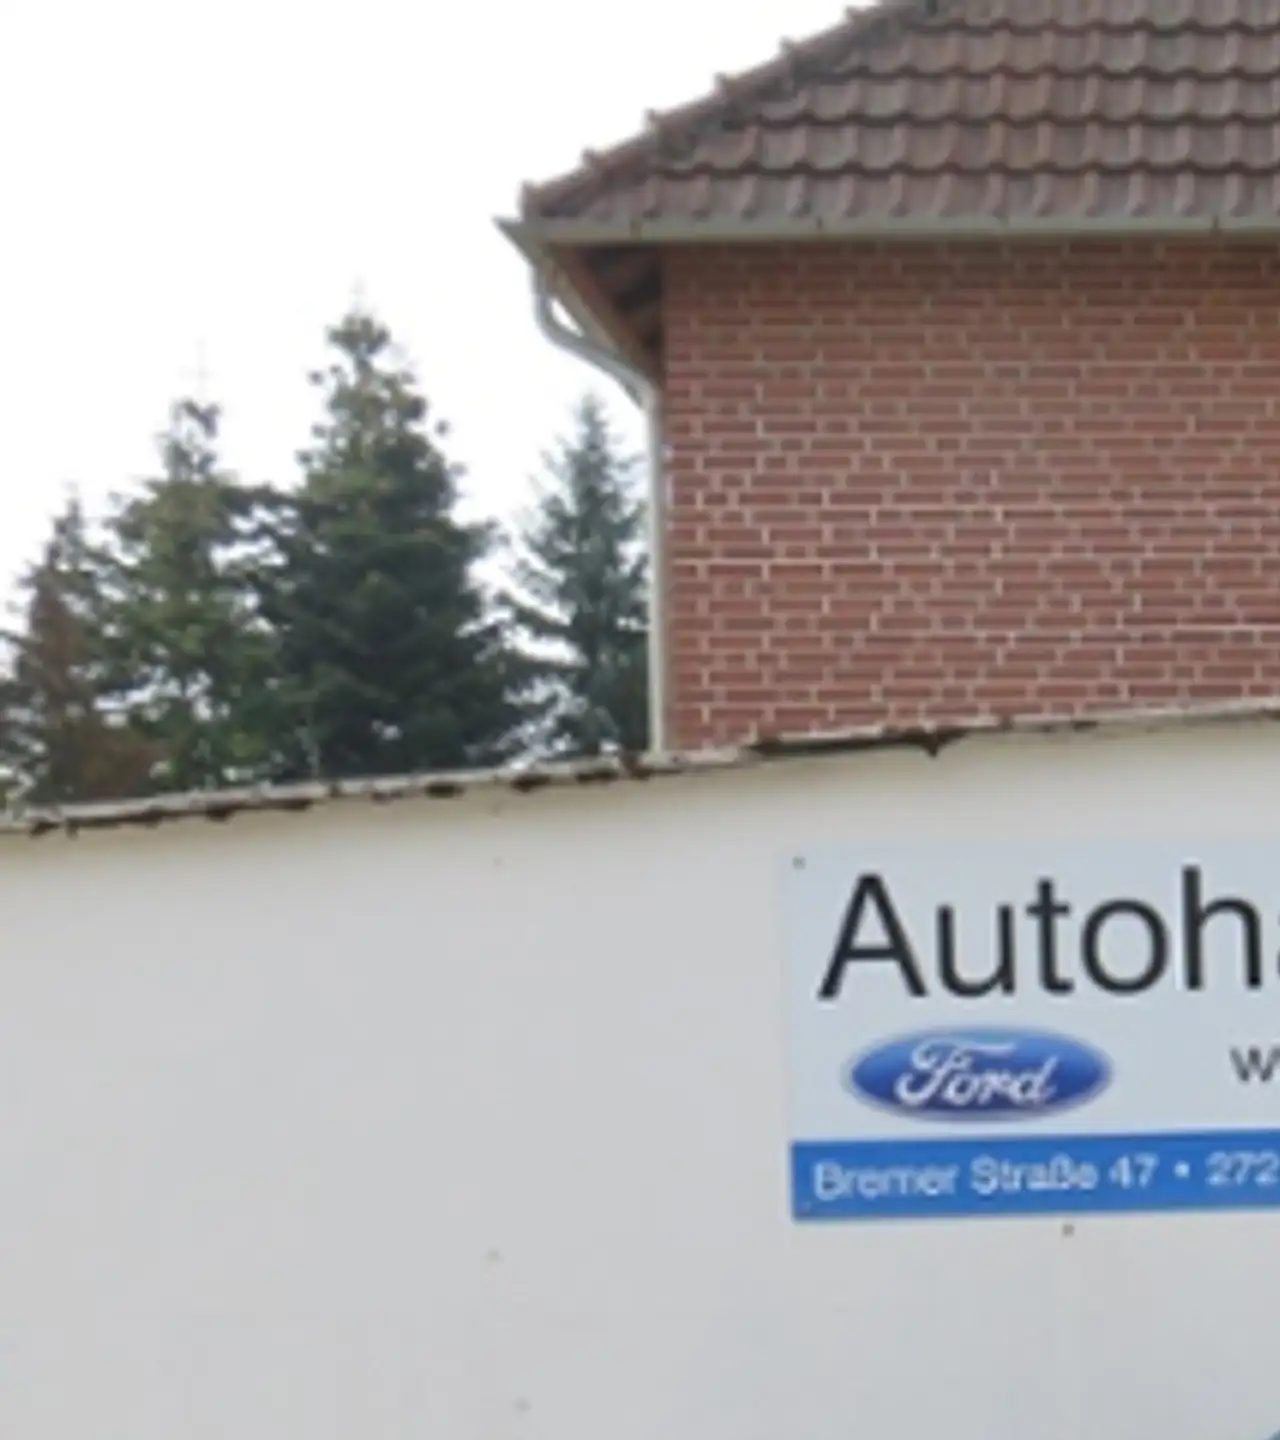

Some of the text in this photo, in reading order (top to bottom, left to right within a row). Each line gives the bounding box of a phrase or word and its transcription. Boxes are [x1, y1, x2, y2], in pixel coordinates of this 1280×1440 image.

[892, 1036, 1060, 1110] Ford
[812, 1158, 960, 1201] Bremer
[969, 1153, 1099, 1197] Straße
[1107, 1151, 1160, 1190] 47
